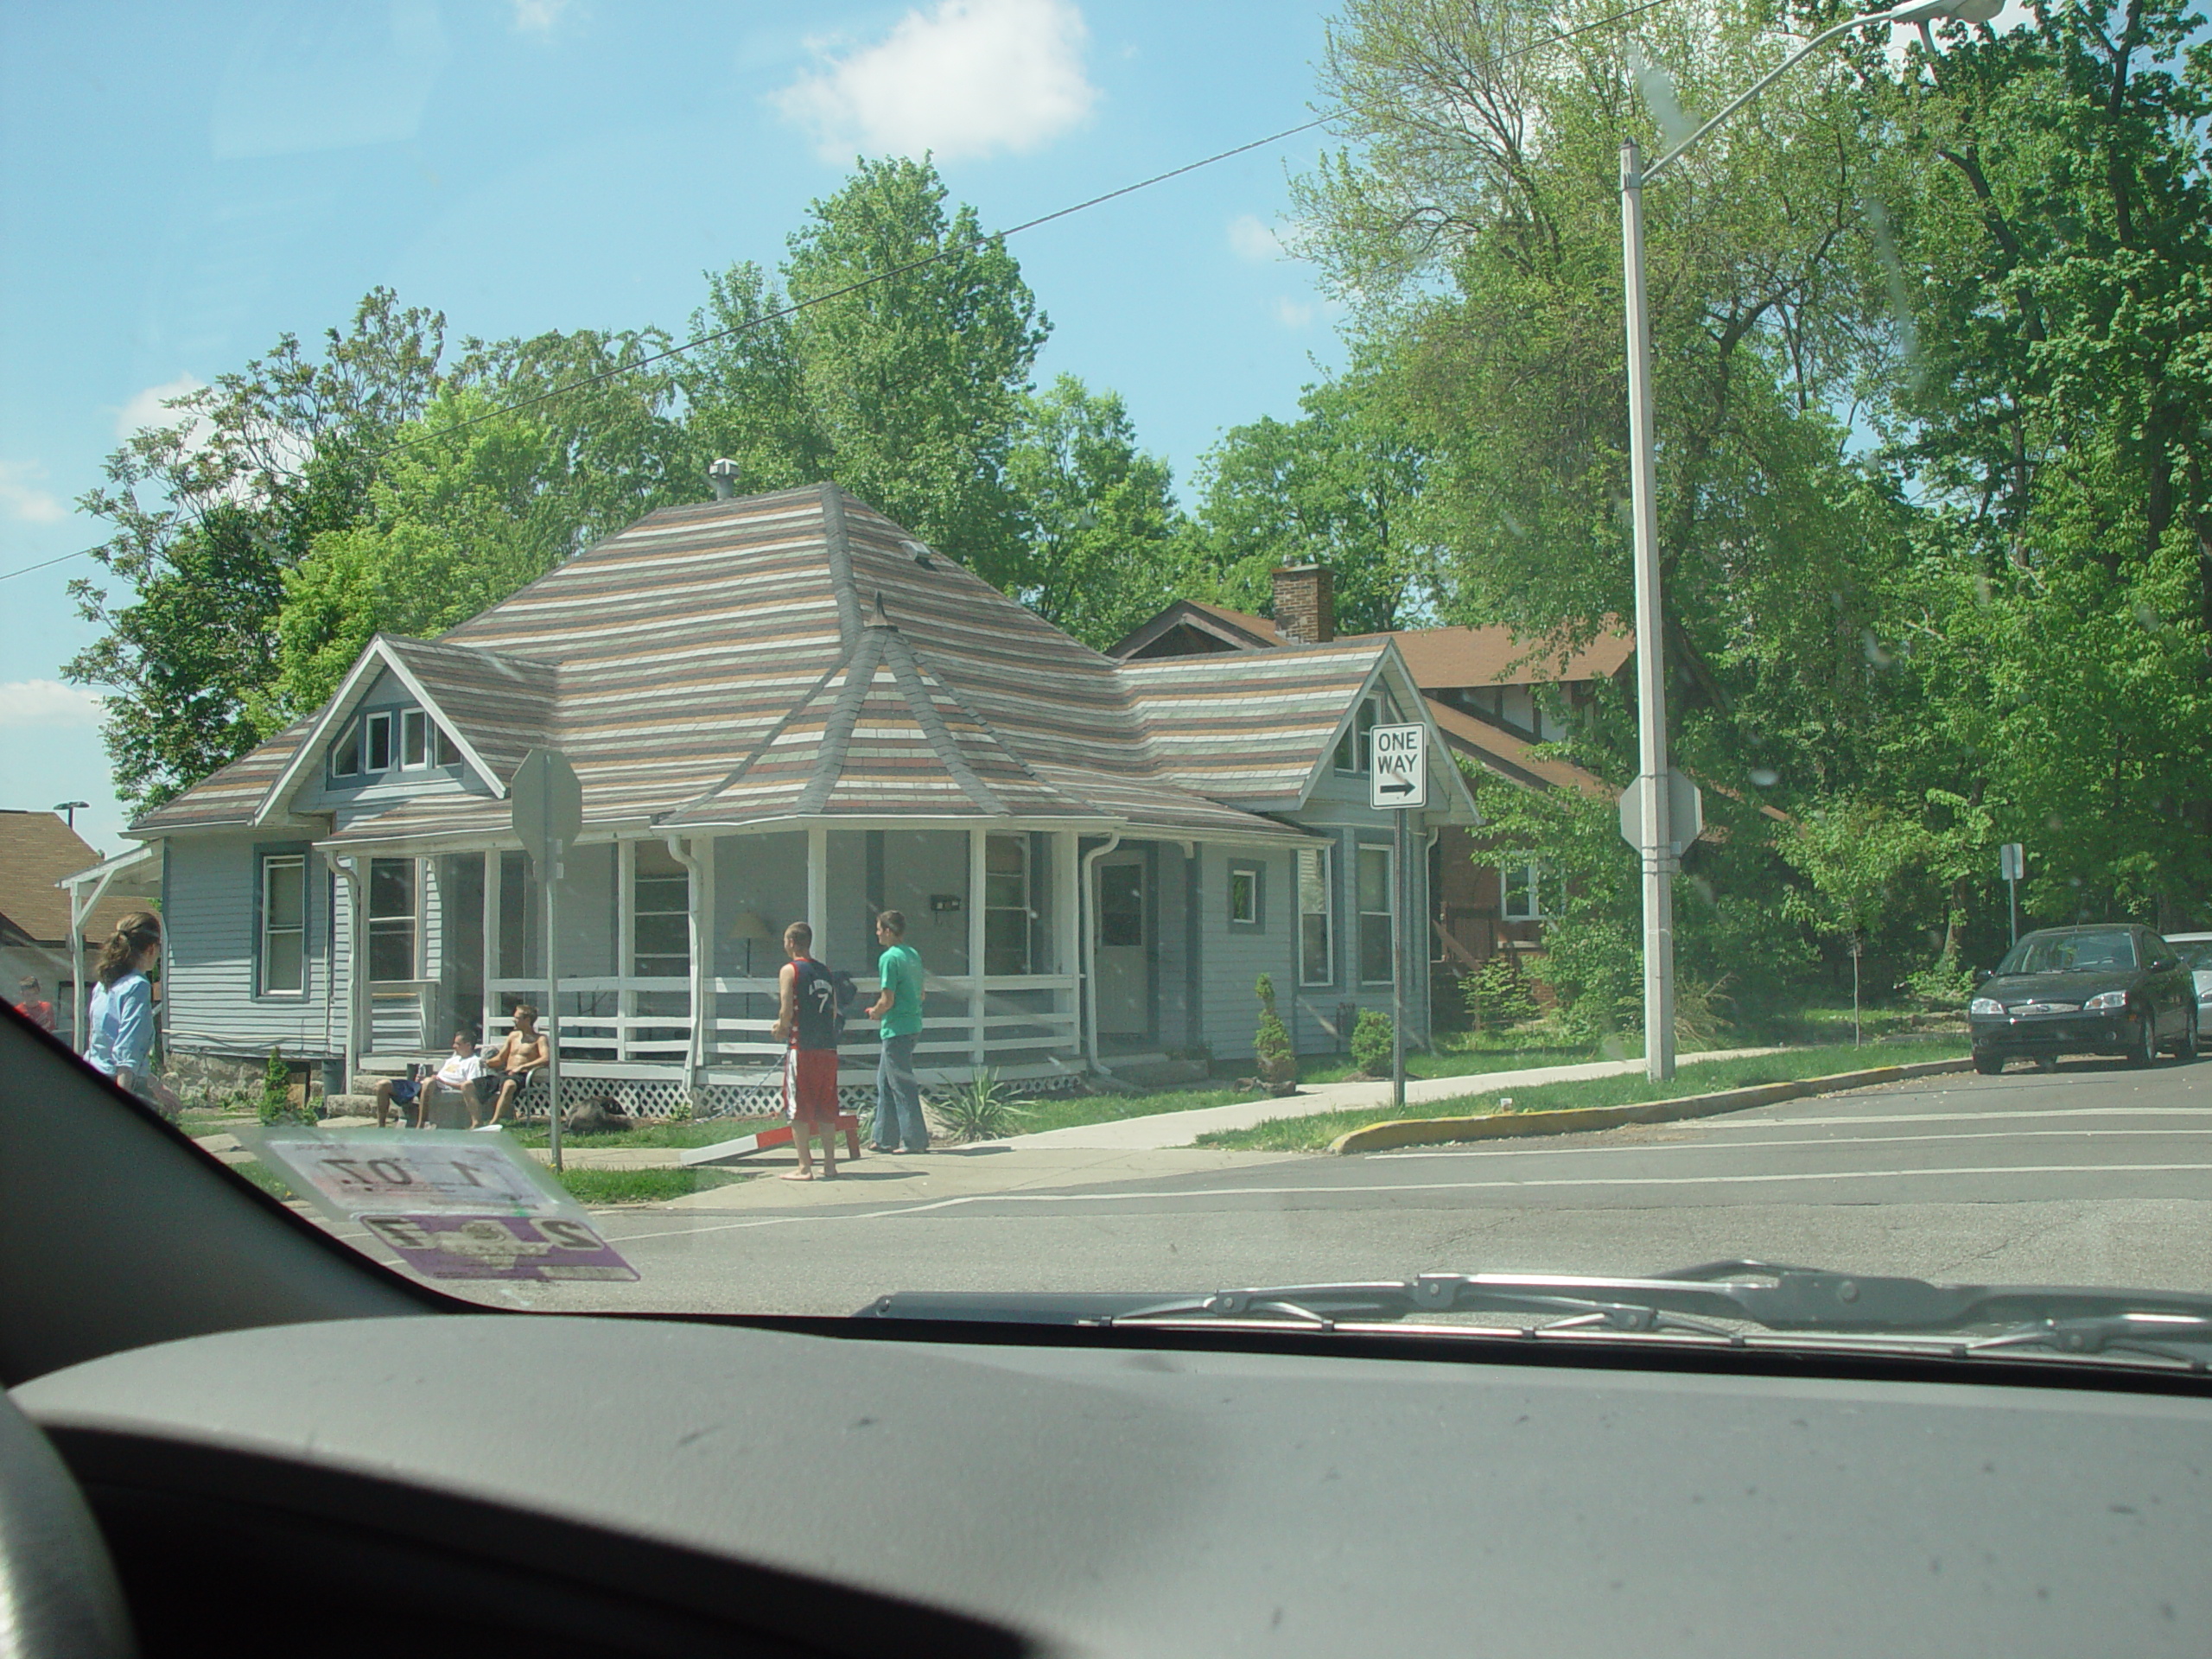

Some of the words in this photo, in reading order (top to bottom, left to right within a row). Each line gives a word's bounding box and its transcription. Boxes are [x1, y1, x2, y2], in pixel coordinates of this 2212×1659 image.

[1378, 731, 1417, 752] ONE
[1377, 753, 1418, 774] WAY
[817, 993, 829, 1014] 7
